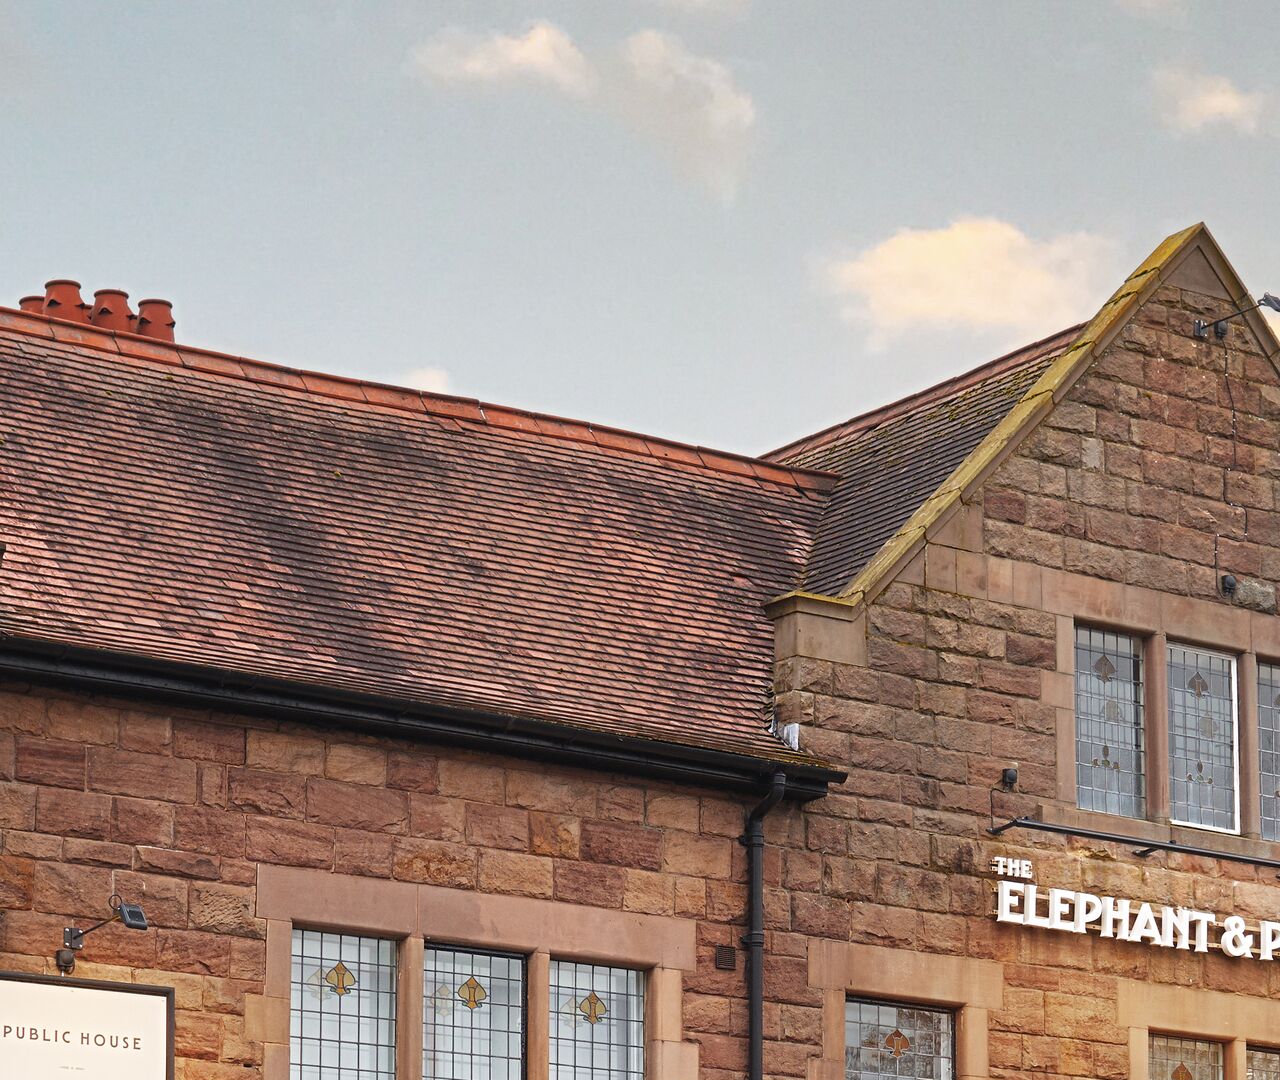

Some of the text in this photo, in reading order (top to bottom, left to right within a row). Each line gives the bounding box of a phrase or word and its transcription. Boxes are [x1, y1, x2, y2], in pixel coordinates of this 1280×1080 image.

[993, 856, 1033, 879] THE
[996, 880, 1216, 953] ELEPHANT
[1220, 915, 1254, 959] &
[3, 1025, 141, 1050] PUBLIC HOUSE
